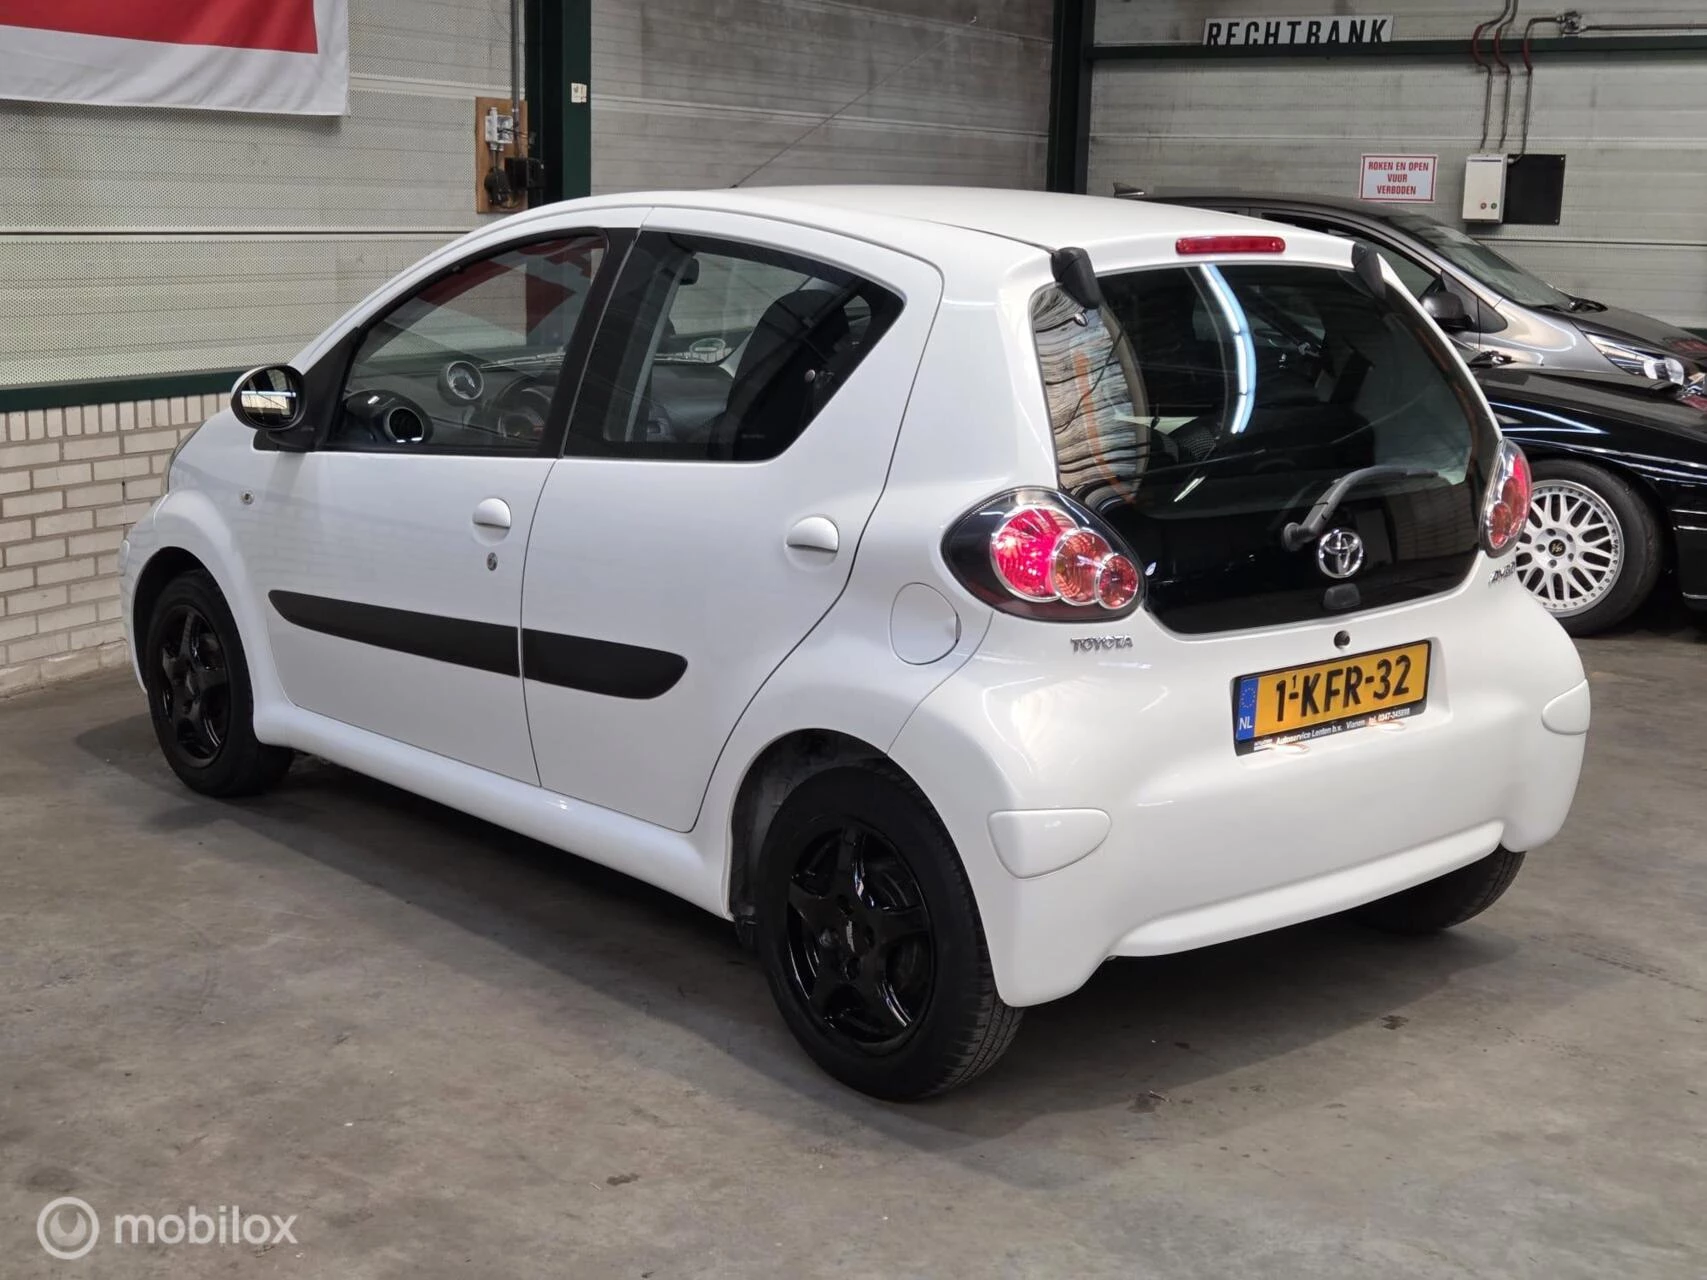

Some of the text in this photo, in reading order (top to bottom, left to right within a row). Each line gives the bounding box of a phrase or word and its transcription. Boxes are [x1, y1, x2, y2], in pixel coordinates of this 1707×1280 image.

[1206, 19, 1387, 45] RECHTBANK
[1368, 161, 1429, 171] ROKEN EN OPEN
[1387, 173, 1408, 182] VUUR
[1377, 185, 1416, 195] VERBODEN
[1070, 636, 1133, 652] TOYOTA
[1239, 716, 1253, 731] NL
[1276, 730, 1311, 745] Autoservice
